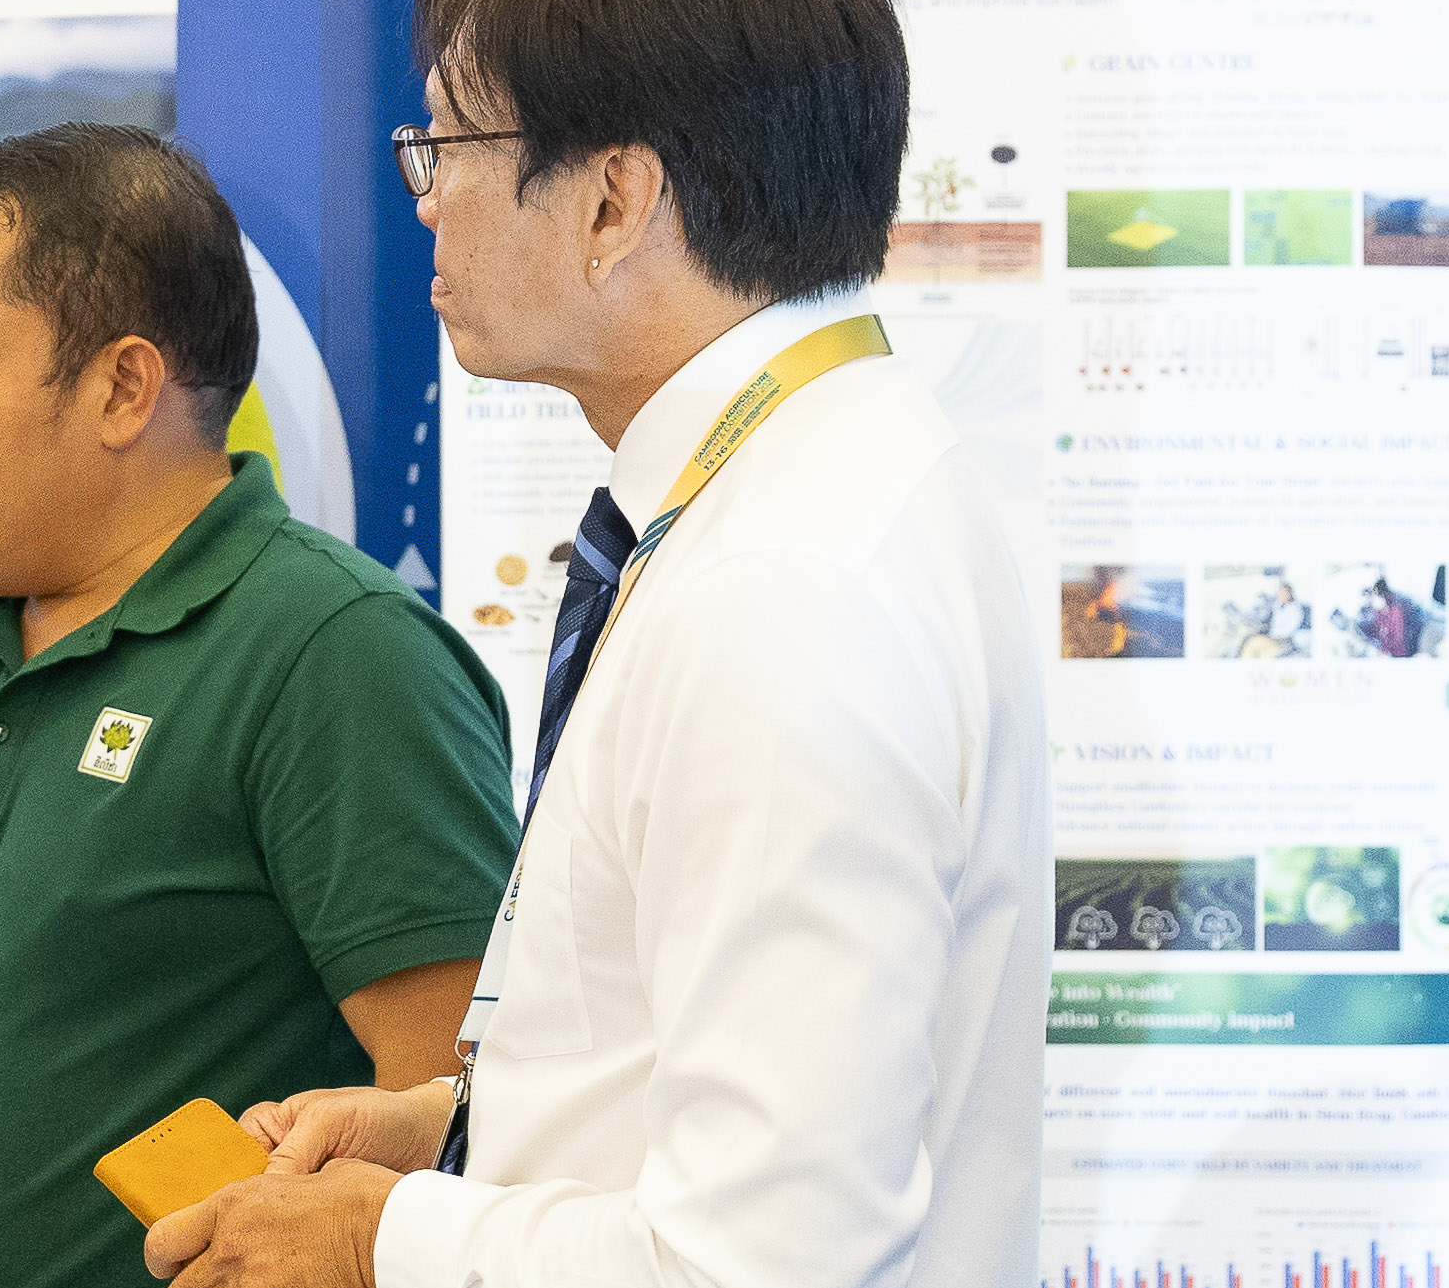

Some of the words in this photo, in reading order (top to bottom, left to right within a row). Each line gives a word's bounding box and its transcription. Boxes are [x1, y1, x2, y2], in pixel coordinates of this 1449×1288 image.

[695, 421, 727, 462] CAMBODIA
[726, 371, 770, 420] AGRICULTURE
[704, 445, 729, 471] 13-16
